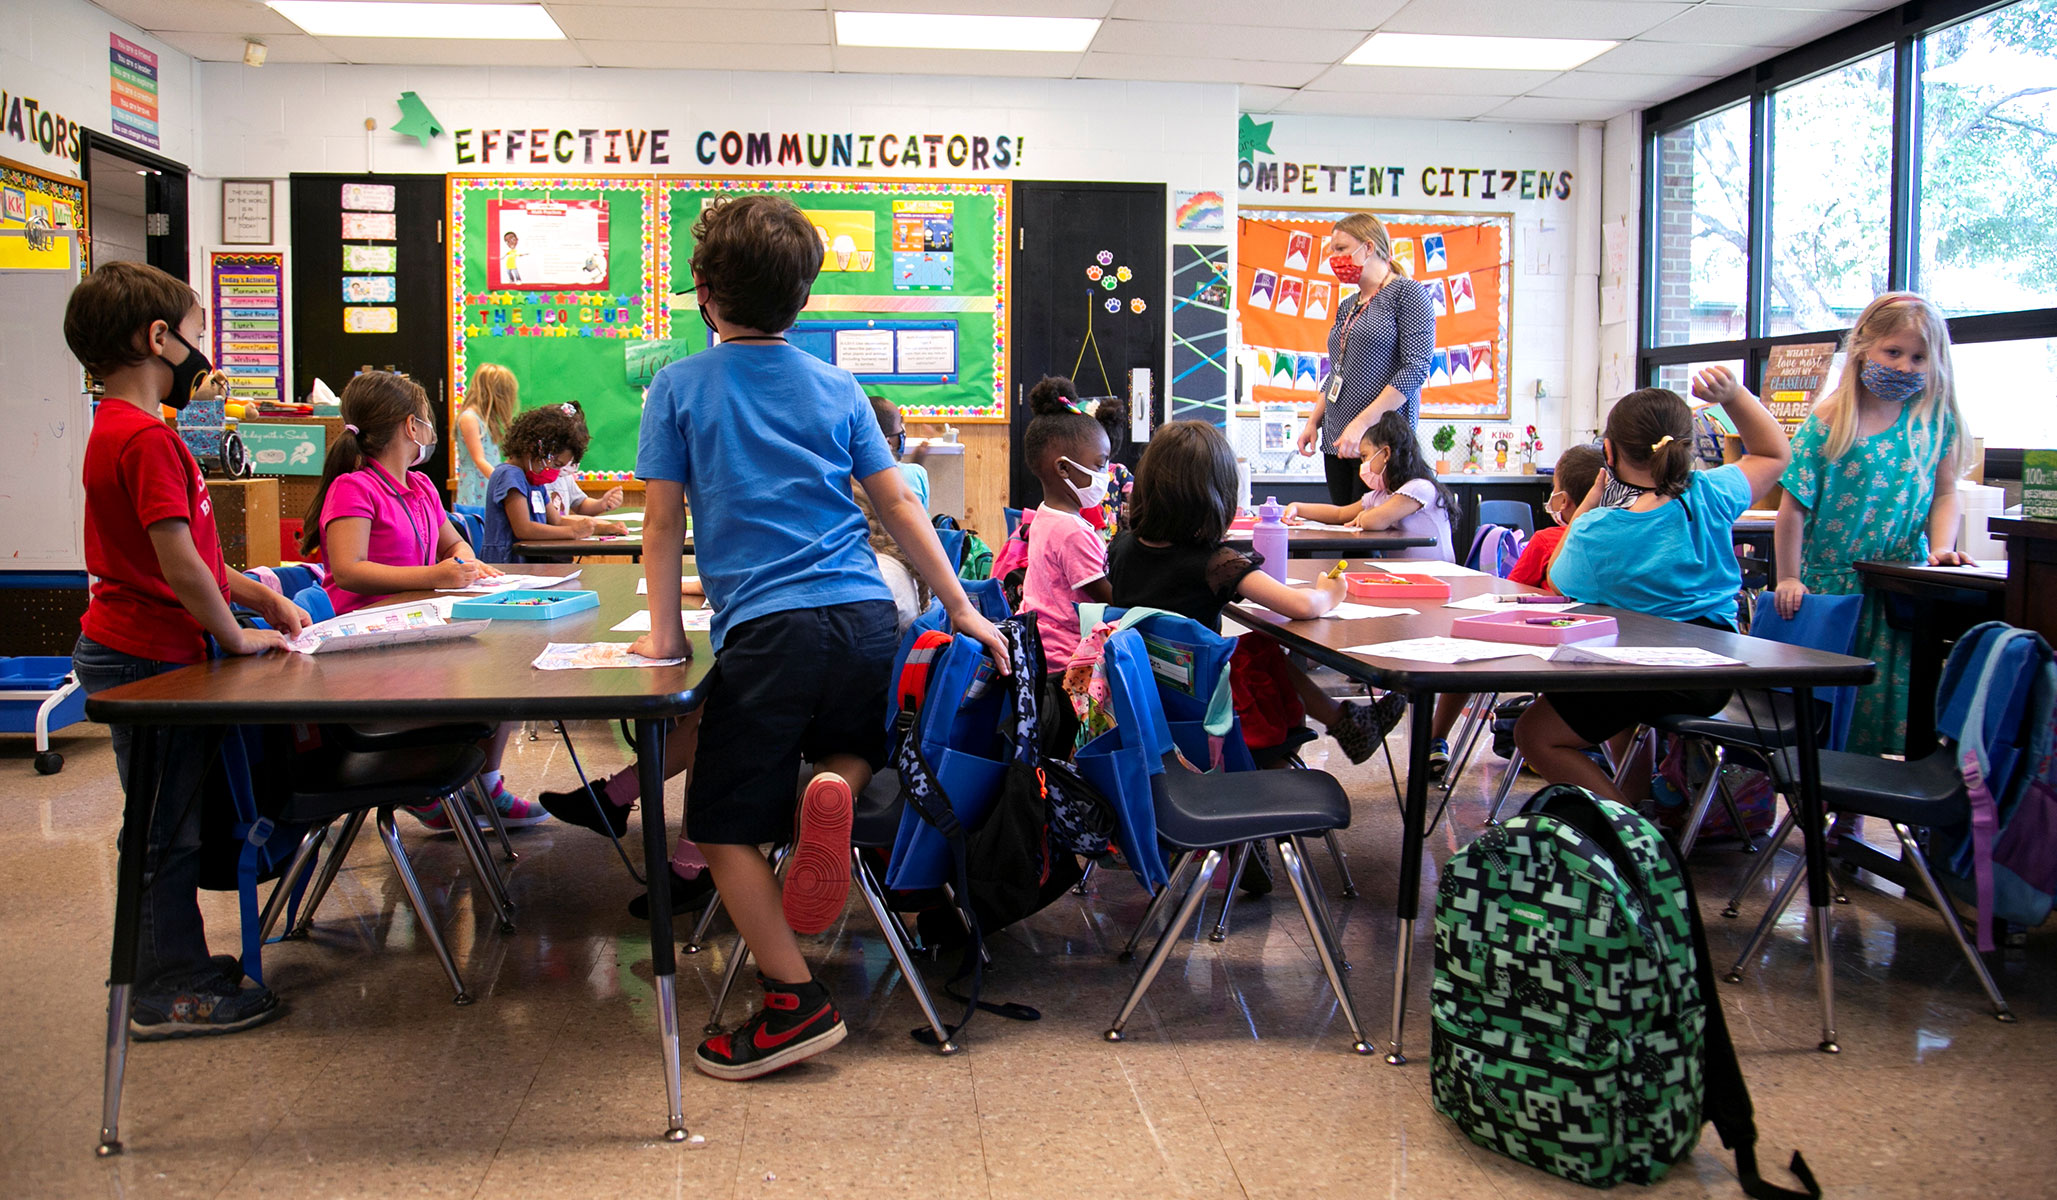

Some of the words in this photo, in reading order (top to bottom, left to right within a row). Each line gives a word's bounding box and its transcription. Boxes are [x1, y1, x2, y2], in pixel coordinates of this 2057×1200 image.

[454, 128, 672, 165] EFFECTIVE
[696, 130, 1025, 171] COMMUNICATORS!
[1420, 166, 1575, 201] CITIZENS
[479, 308, 524, 325] THE
[579, 307, 630, 324] CLUB
[1785, 349, 1809, 357] WHAT
[1776, 356, 1798, 369] love
[1799, 355, 1823, 368] most
[1780, 368, 1801, 376] ABOUT
[1802, 368, 1813, 376] MY
[1770, 376, 1819, 391] CLASSROOM
[1768, 402, 1810, 417] SHARE
[1491, 431, 1514, 440] KIND
